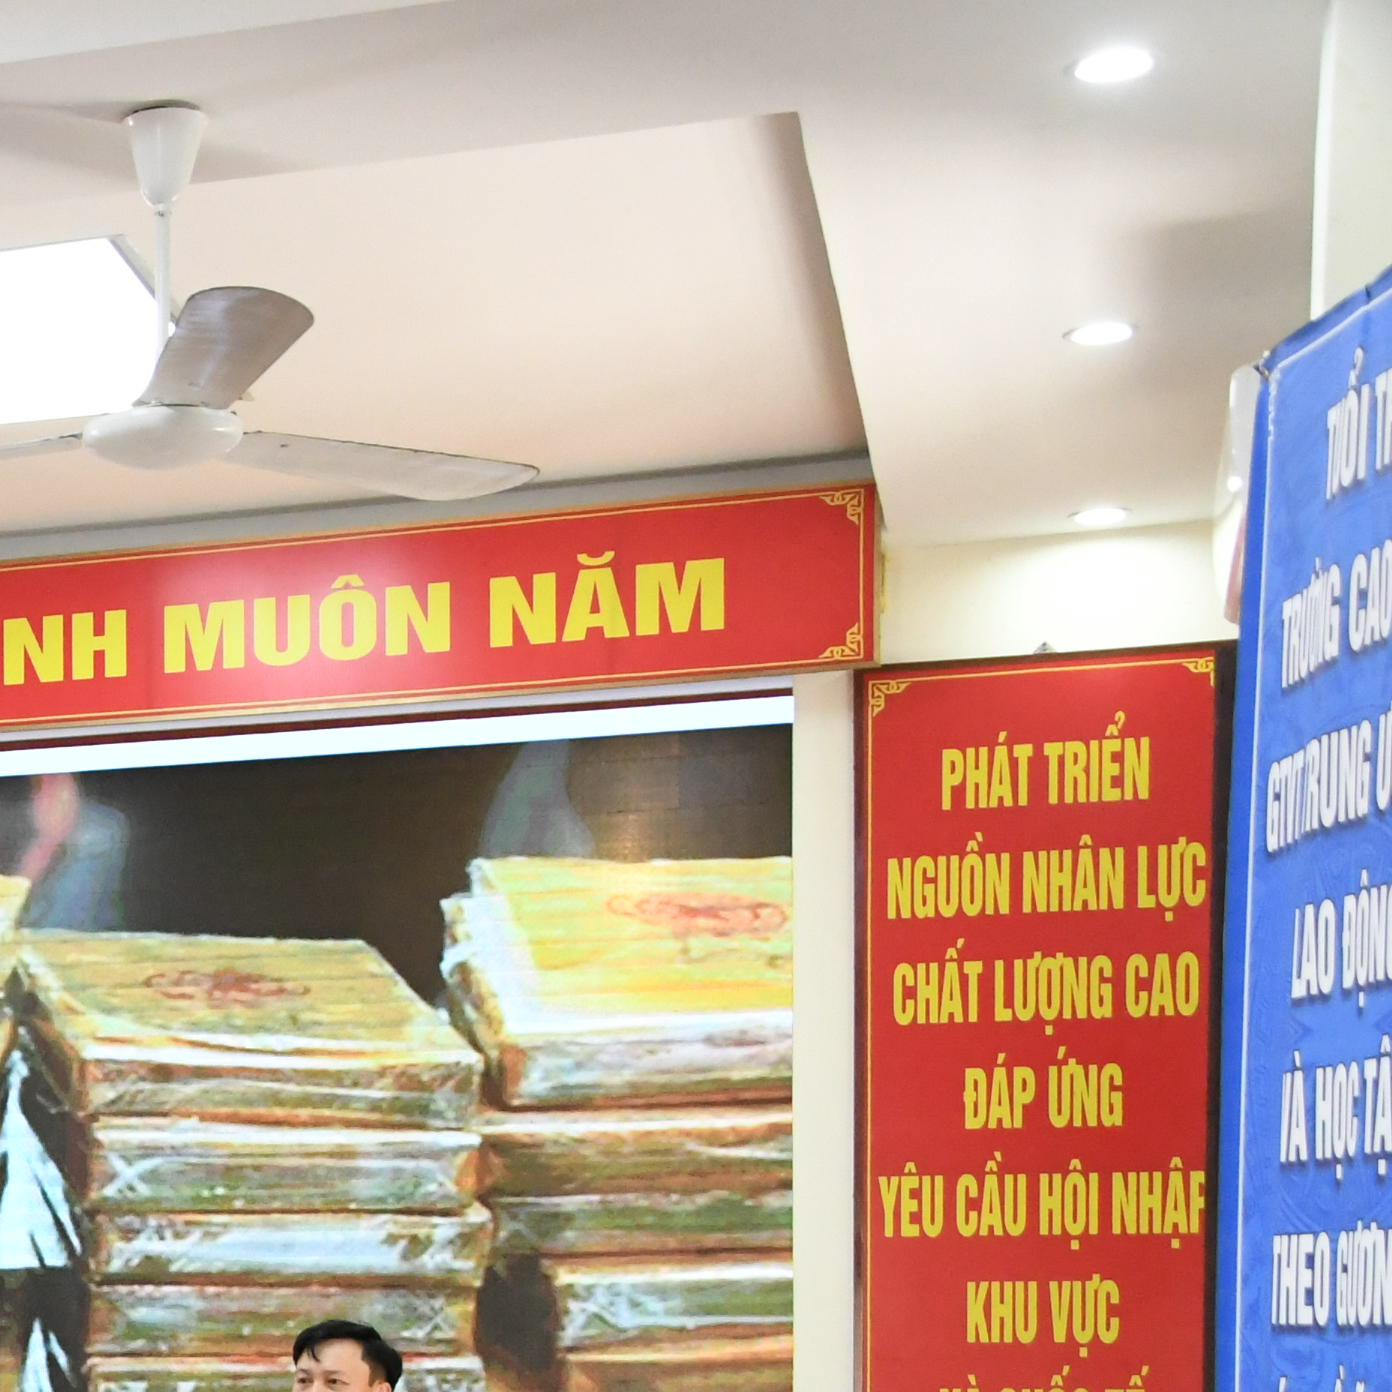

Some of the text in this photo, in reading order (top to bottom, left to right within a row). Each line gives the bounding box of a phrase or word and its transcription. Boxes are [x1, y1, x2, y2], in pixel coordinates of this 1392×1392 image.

[164, 574, 451, 674] MUÔN
[490, 551, 725, 648] NĂM
[942, 711, 1149, 810] PHÁT TRIỂN
[888, 832, 1206, 921] NGUỒN NHÂN LỰC
[894, 938, 1199, 1035] CHẤT LƯỢNG CAO
[1291, 899, 1335, 999] LAO
[964, 1046, 1122, 1129] ĐÁP ỨNG
[1316, 1061, 1360, 1179] HỌC
[879, 1162, 943, 1237] YÊU
[956, 1152, 1026, 1237] CẦU
[1040, 1159, 1098, 1249] HỘI
[967, 1274, 1119, 1357] KHU VỰC
[1272, 1232, 1330, 1326] THEO
